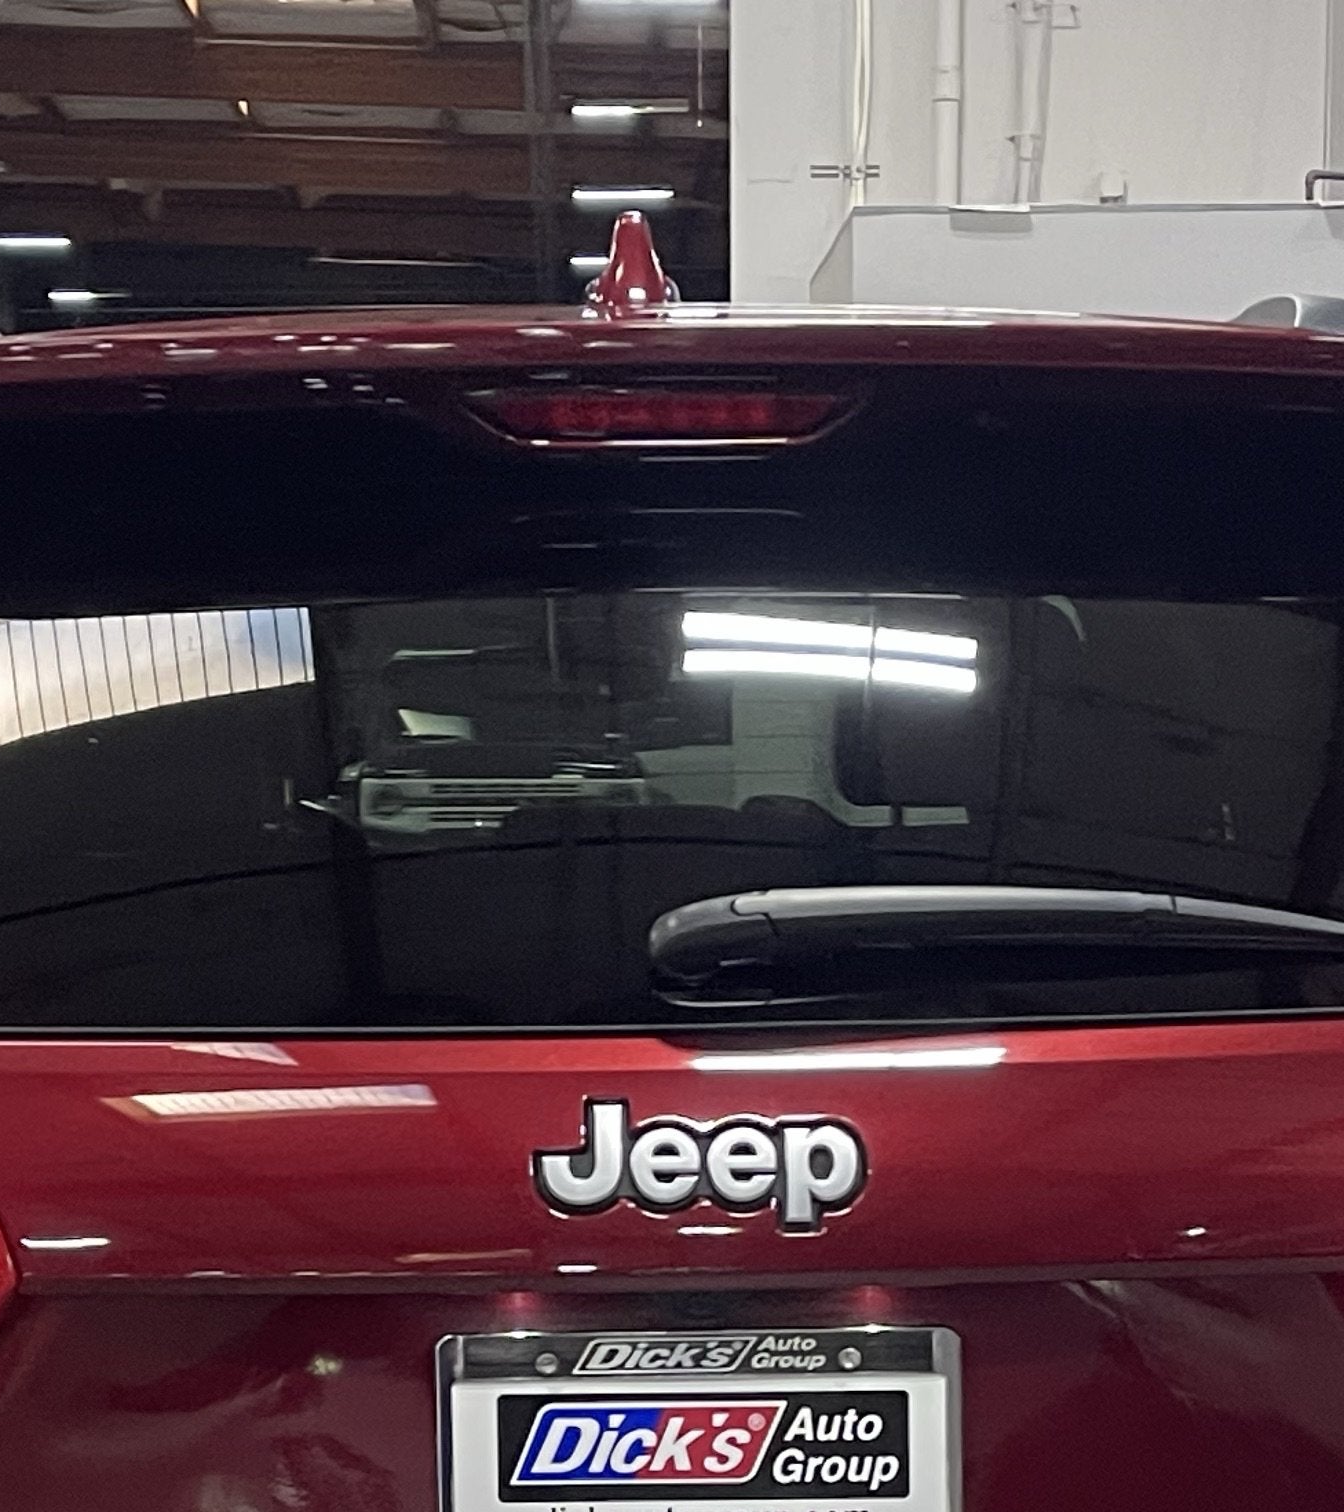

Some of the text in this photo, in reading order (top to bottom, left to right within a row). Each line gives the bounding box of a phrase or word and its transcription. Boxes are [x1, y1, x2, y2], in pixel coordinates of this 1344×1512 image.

[536, 1100, 862, 1226] Jeep
[585, 1342, 735, 1369] Dick's
[751, 1352, 827, 1371] Group
[757, 1336, 818, 1352] Auto
[784, 1406, 884, 1443] Auto
[530, 1412, 753, 1475] Dick's
[772, 1449, 900, 1491] Group
